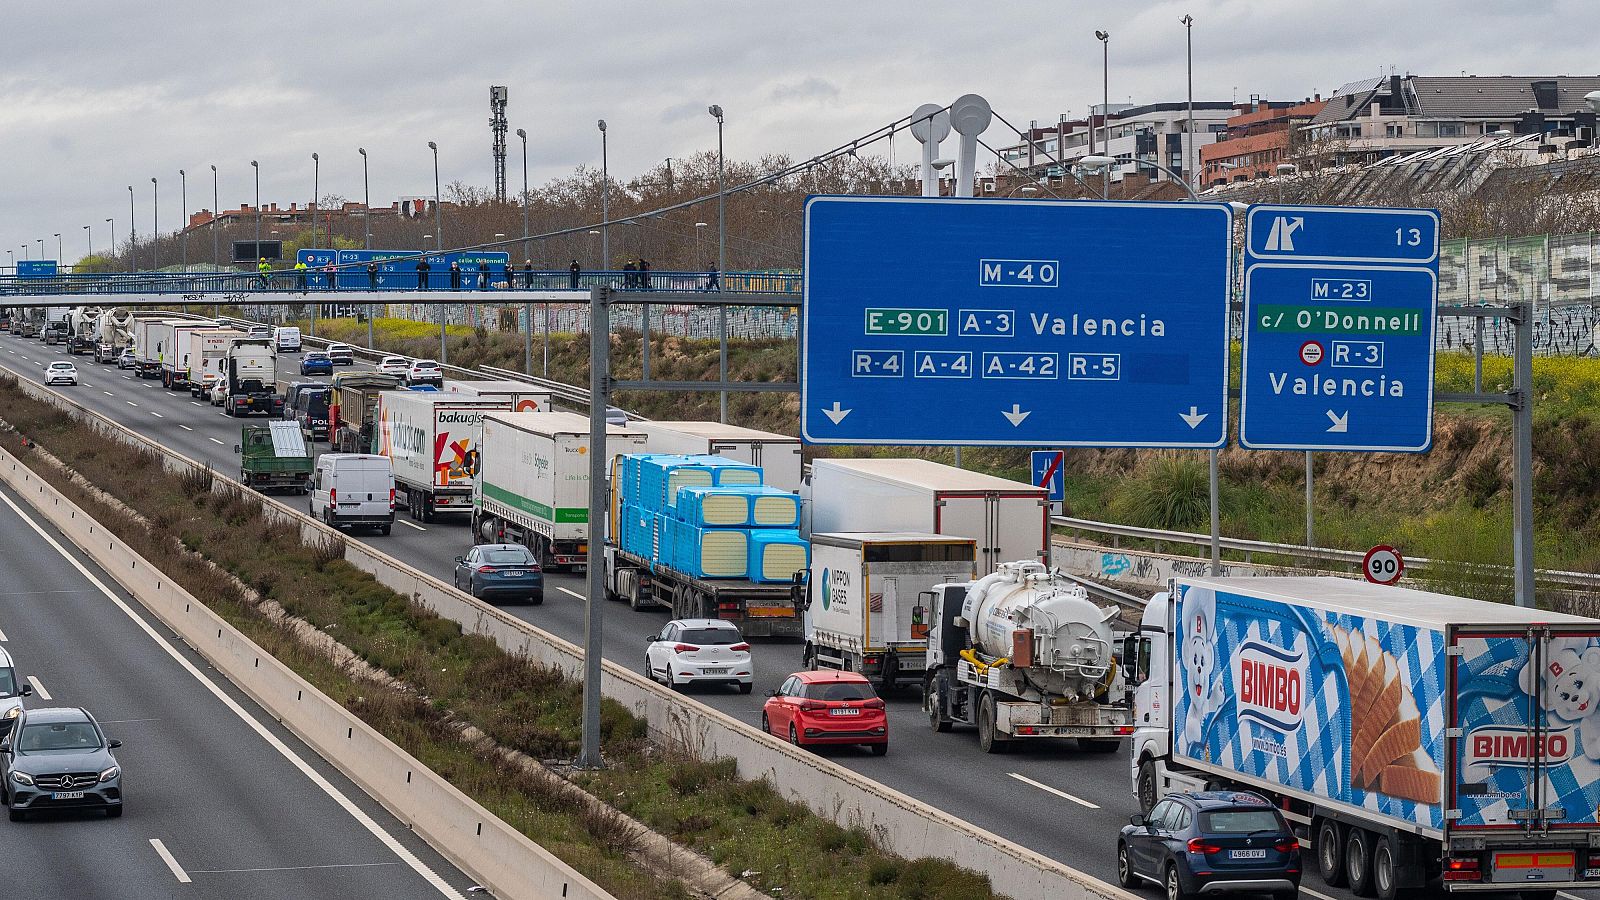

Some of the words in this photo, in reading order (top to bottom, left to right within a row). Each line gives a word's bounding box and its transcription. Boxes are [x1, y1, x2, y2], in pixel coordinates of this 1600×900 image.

[1395, 228, 1421, 247] 13
[984, 264, 1054, 283] M-40
[1314, 282, 1367, 298] M-23
[869, 312, 944, 332] E-901
[964, 314, 1010, 333] A-3
[1031, 313, 1165, 337] Valencia
[1261, 313, 1284, 328] c/
[1297, 310, 1418, 331] O'Donnell
[1335, 345, 1379, 364] R-3
[857, 355, 899, 373] R-4
[919, 355, 968, 374] A-4
[987, 356, 1054, 375] A-42
[1073, 357, 1116, 375] R-5
[1269, 373, 1404, 398] Valencia
[1372, 559, 1396, 574] 90
[832, 569, 851, 587] NIPPON
[832, 588, 847, 605] GASES
[1548, 661, 1564, 678] B
[1240, 658, 1301, 716] BIMBO
[1474, 735, 1568, 758] BIMBO
[1233, 850, 1250, 858] 4966
